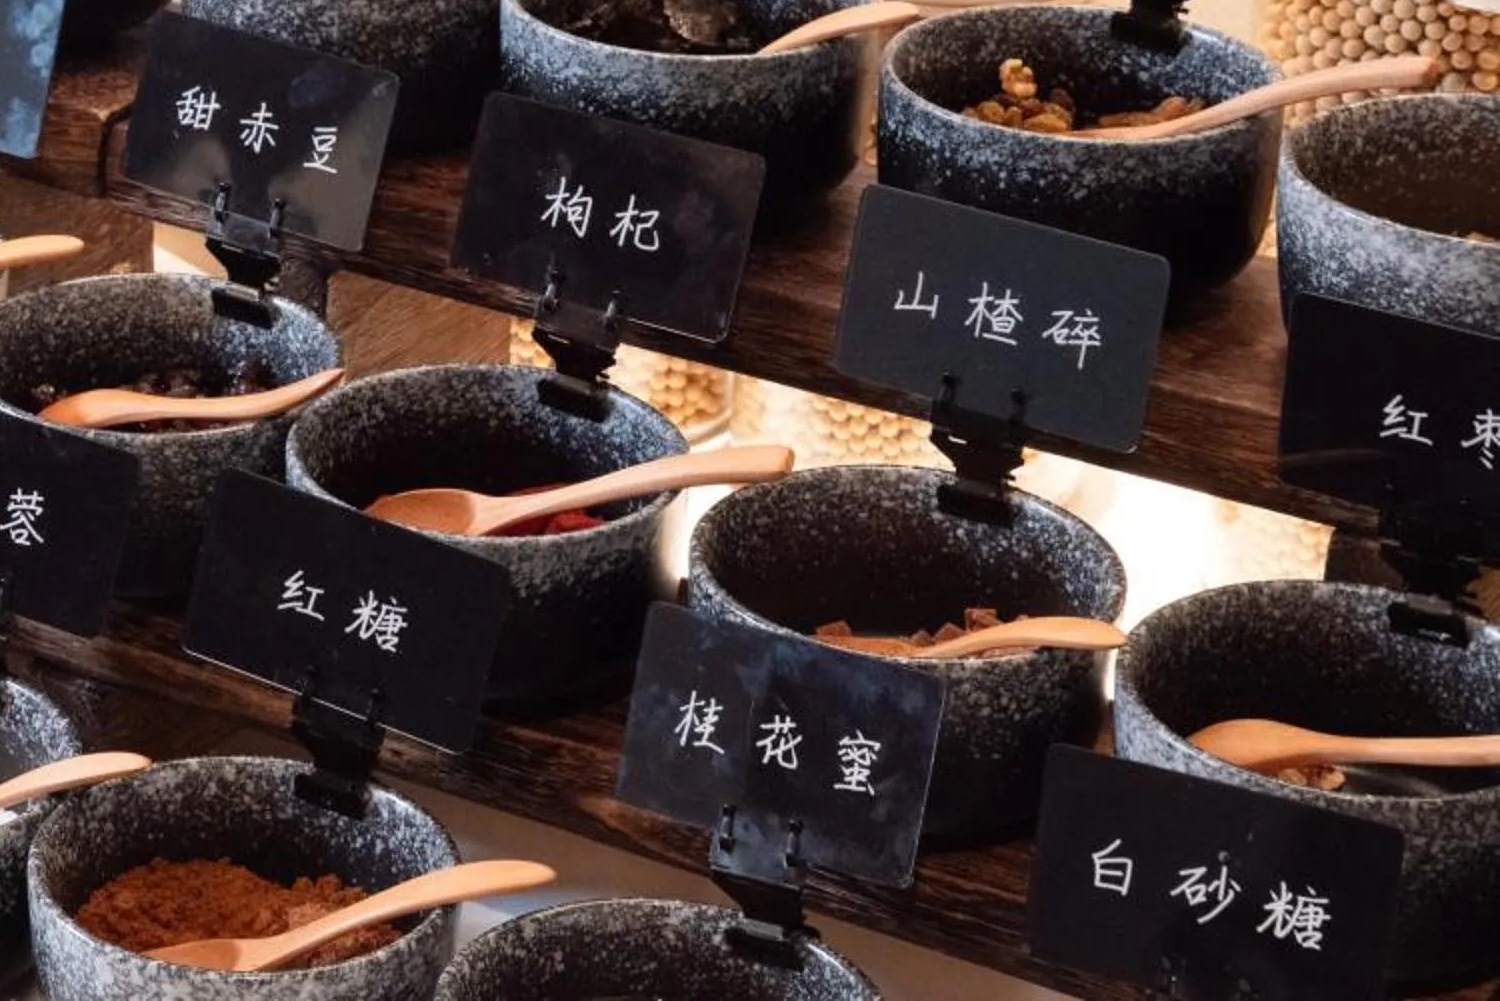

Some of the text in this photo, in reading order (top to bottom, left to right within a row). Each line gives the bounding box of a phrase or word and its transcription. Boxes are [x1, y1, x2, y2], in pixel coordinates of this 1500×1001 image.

[174, 85, 339, 175] 甜赤豆
[540, 175, 661, 252] 枸杞
[893, 270, 1102, 370] 山楂碎
[276, 569, 409, 654] 红糖
[673, 689, 882, 797] 桂花蜜
[1090, 837, 1332, 951] 白砂糖
